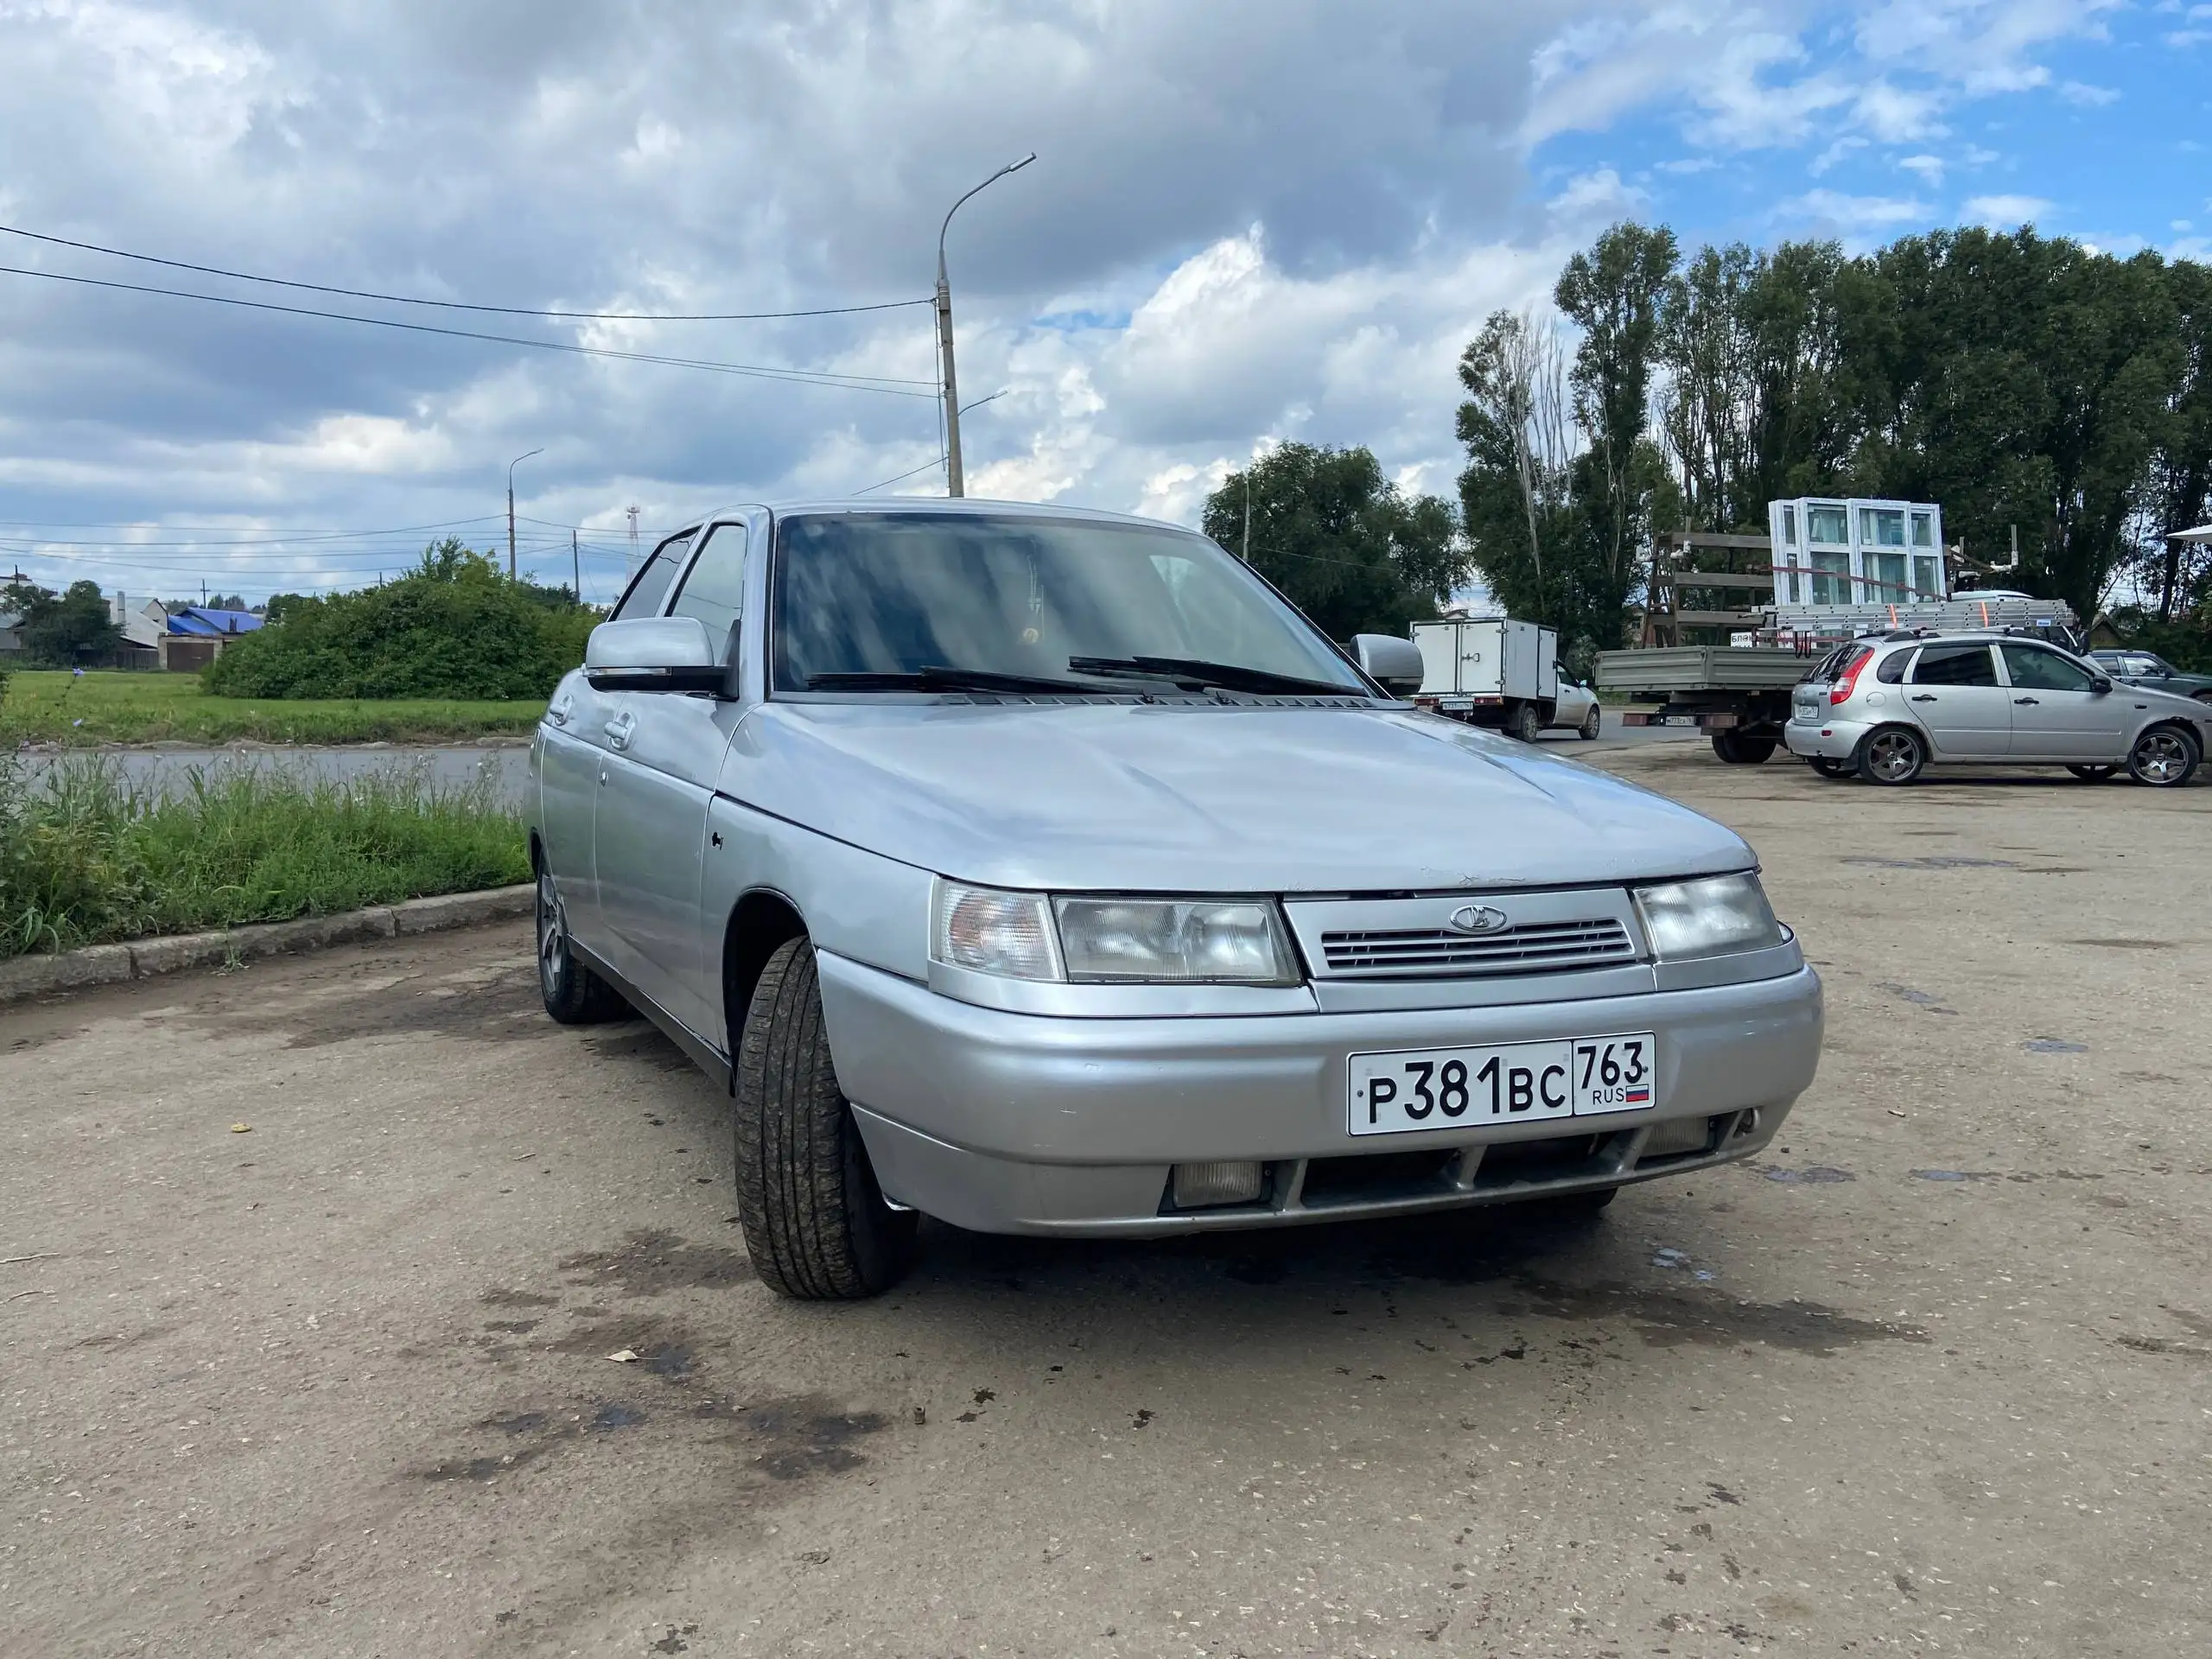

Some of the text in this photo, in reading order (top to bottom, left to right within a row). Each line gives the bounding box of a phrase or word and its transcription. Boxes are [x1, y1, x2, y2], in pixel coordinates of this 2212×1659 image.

[1577, 1041, 1643, 1089] 763
[1370, 1056, 1566, 1124] Р381ВС
[1592, 1088, 1625, 1105] RUS
